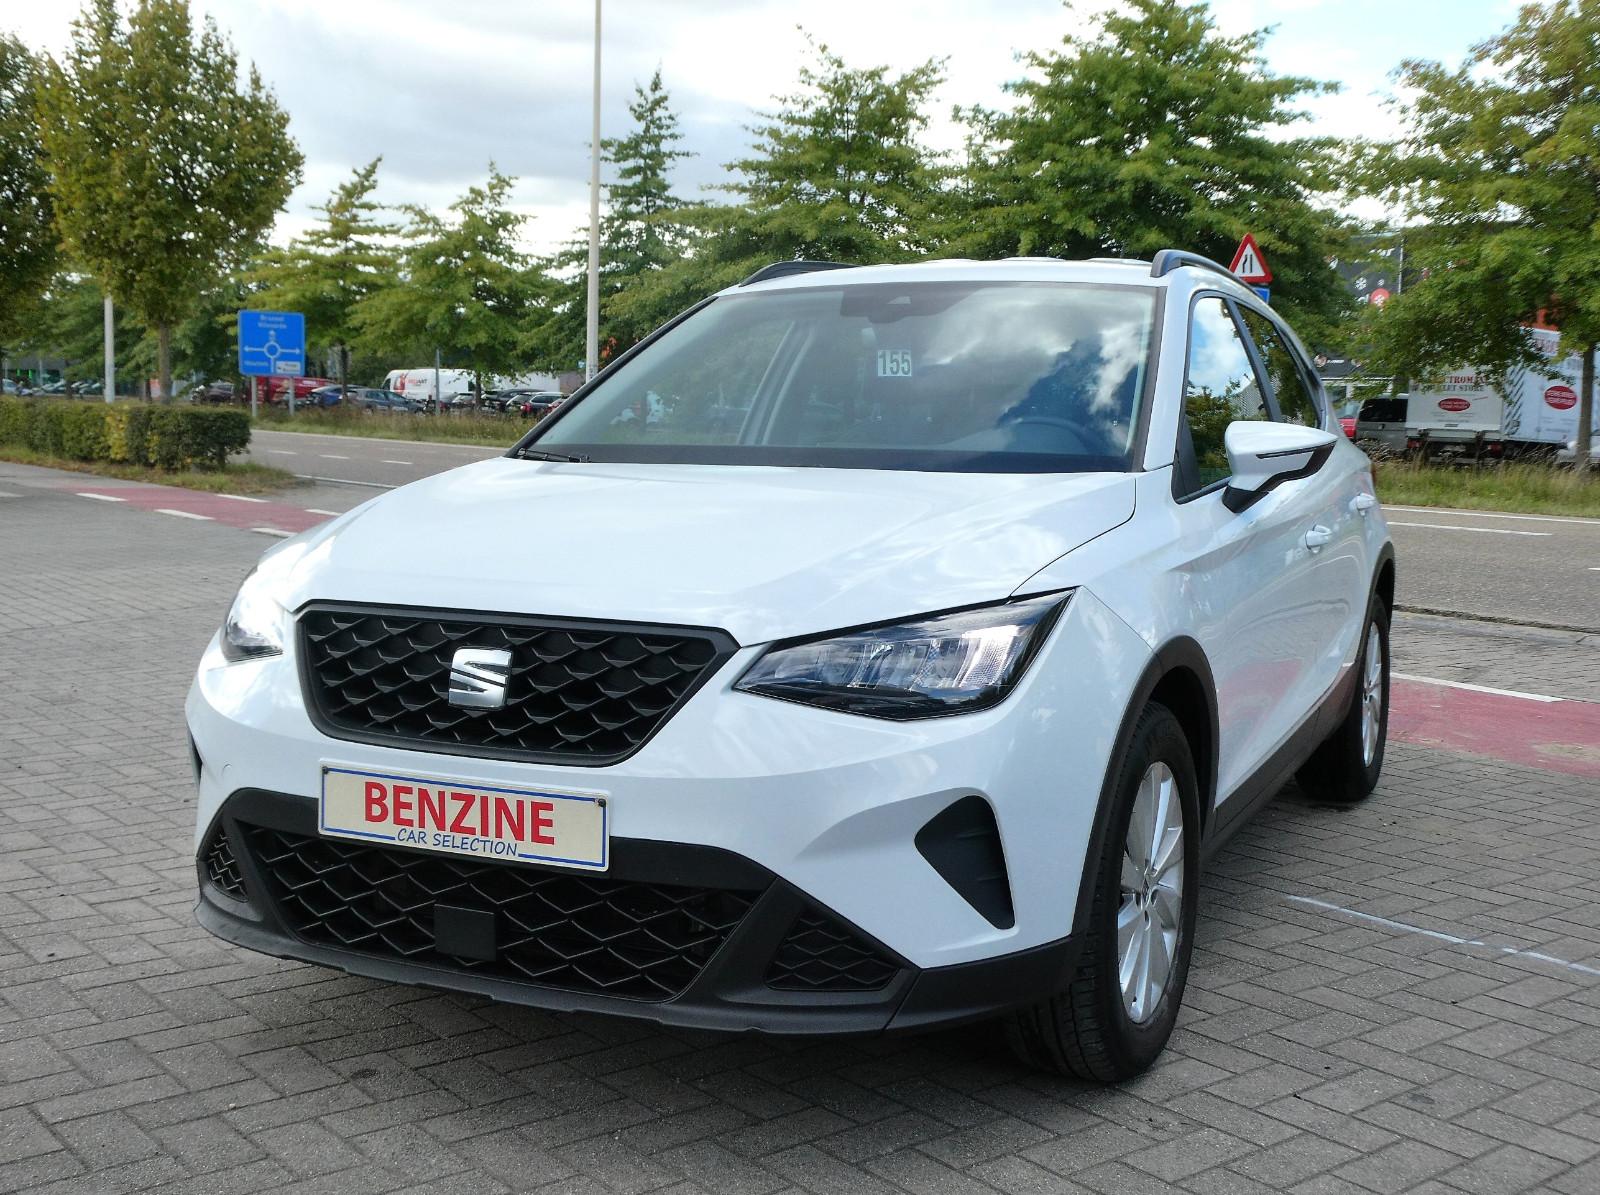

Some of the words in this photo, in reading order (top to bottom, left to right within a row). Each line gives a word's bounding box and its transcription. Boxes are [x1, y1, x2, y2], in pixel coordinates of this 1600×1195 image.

[879, 351, 911, 375] 155
[364, 781, 555, 846] BENZINE
[397, 828, 428, 845] CAR
[432, 833, 518, 857] SELECTION
